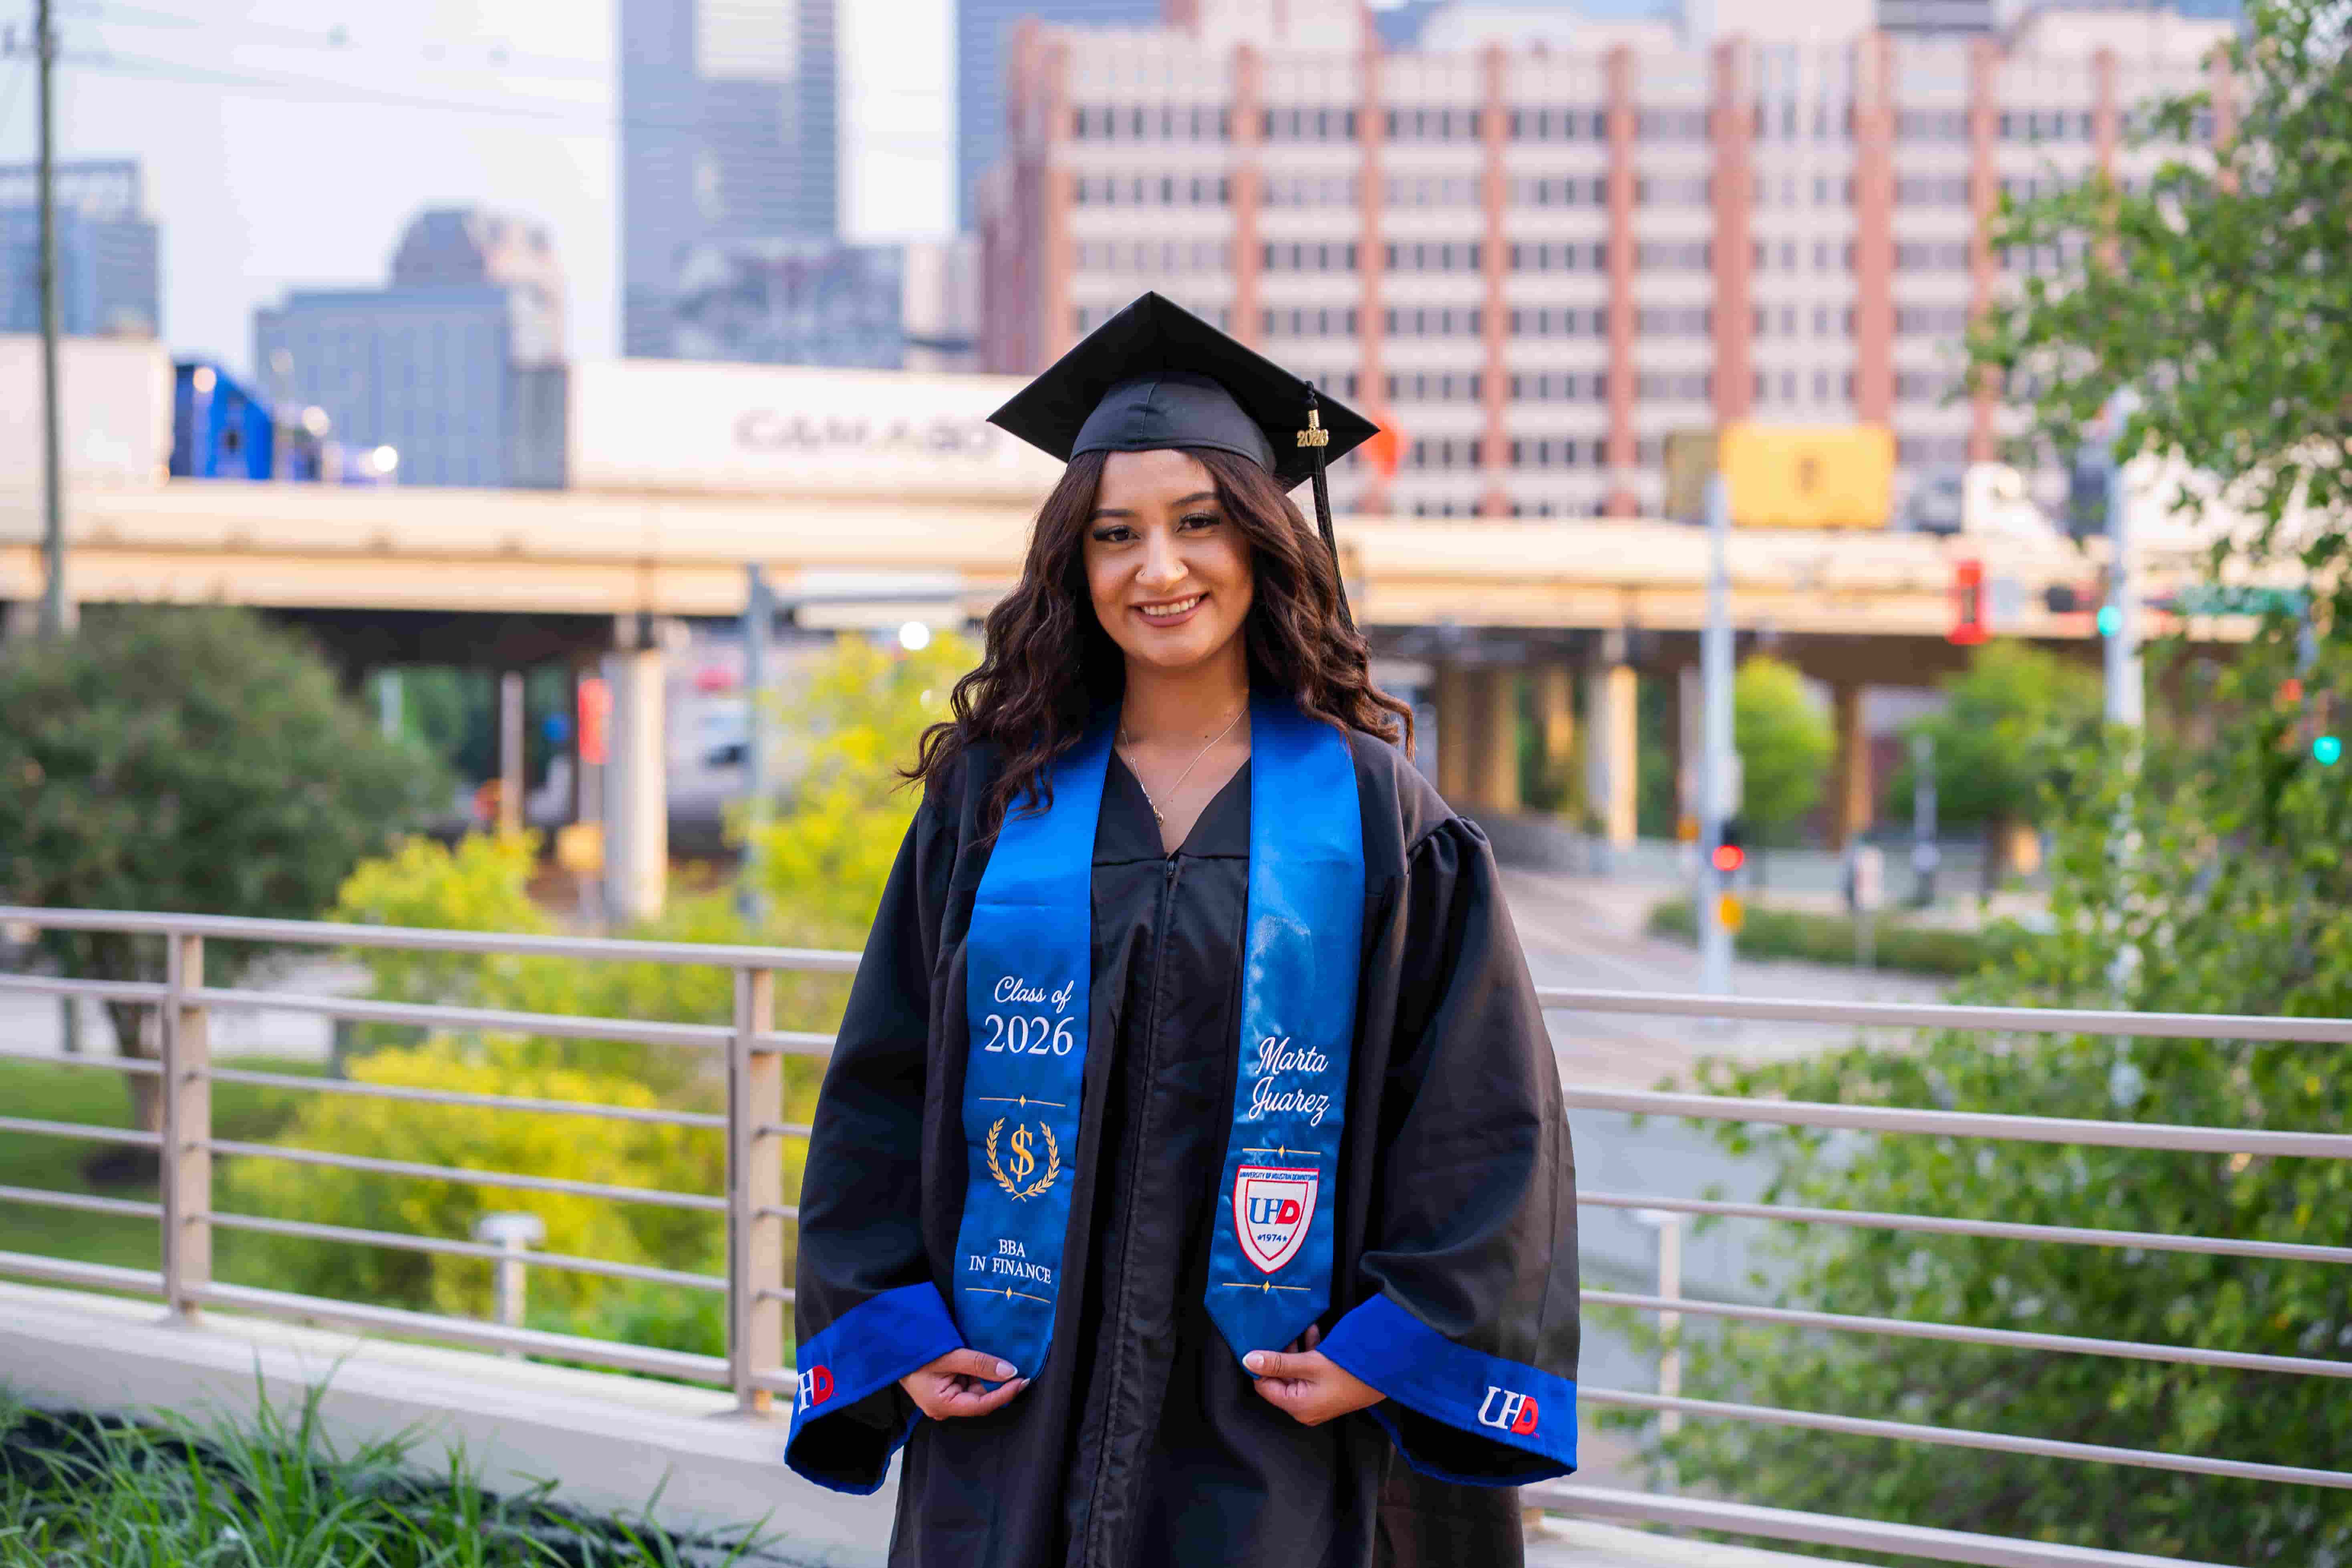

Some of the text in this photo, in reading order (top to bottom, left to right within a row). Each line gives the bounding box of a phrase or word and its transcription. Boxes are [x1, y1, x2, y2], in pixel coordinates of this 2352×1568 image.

[994, 976, 1074, 1013] Class of
[985, 1014, 1074, 1056] 2026
[1255, 1037, 1329, 1075] Marta
[1248, 1076, 1330, 1127] Juarez
[1010, 1123, 1035, 1182] $
[1249, 1198, 1300, 1224] UHD
[998, 1239, 1026, 1258] BBA
[1263, 1234, 1282, 1242] 1974
[969, 1255, 1051, 1284] IN FINANCE
[798, 1365, 834, 1415] HD
[1478, 1386, 1539, 1436] UHD
